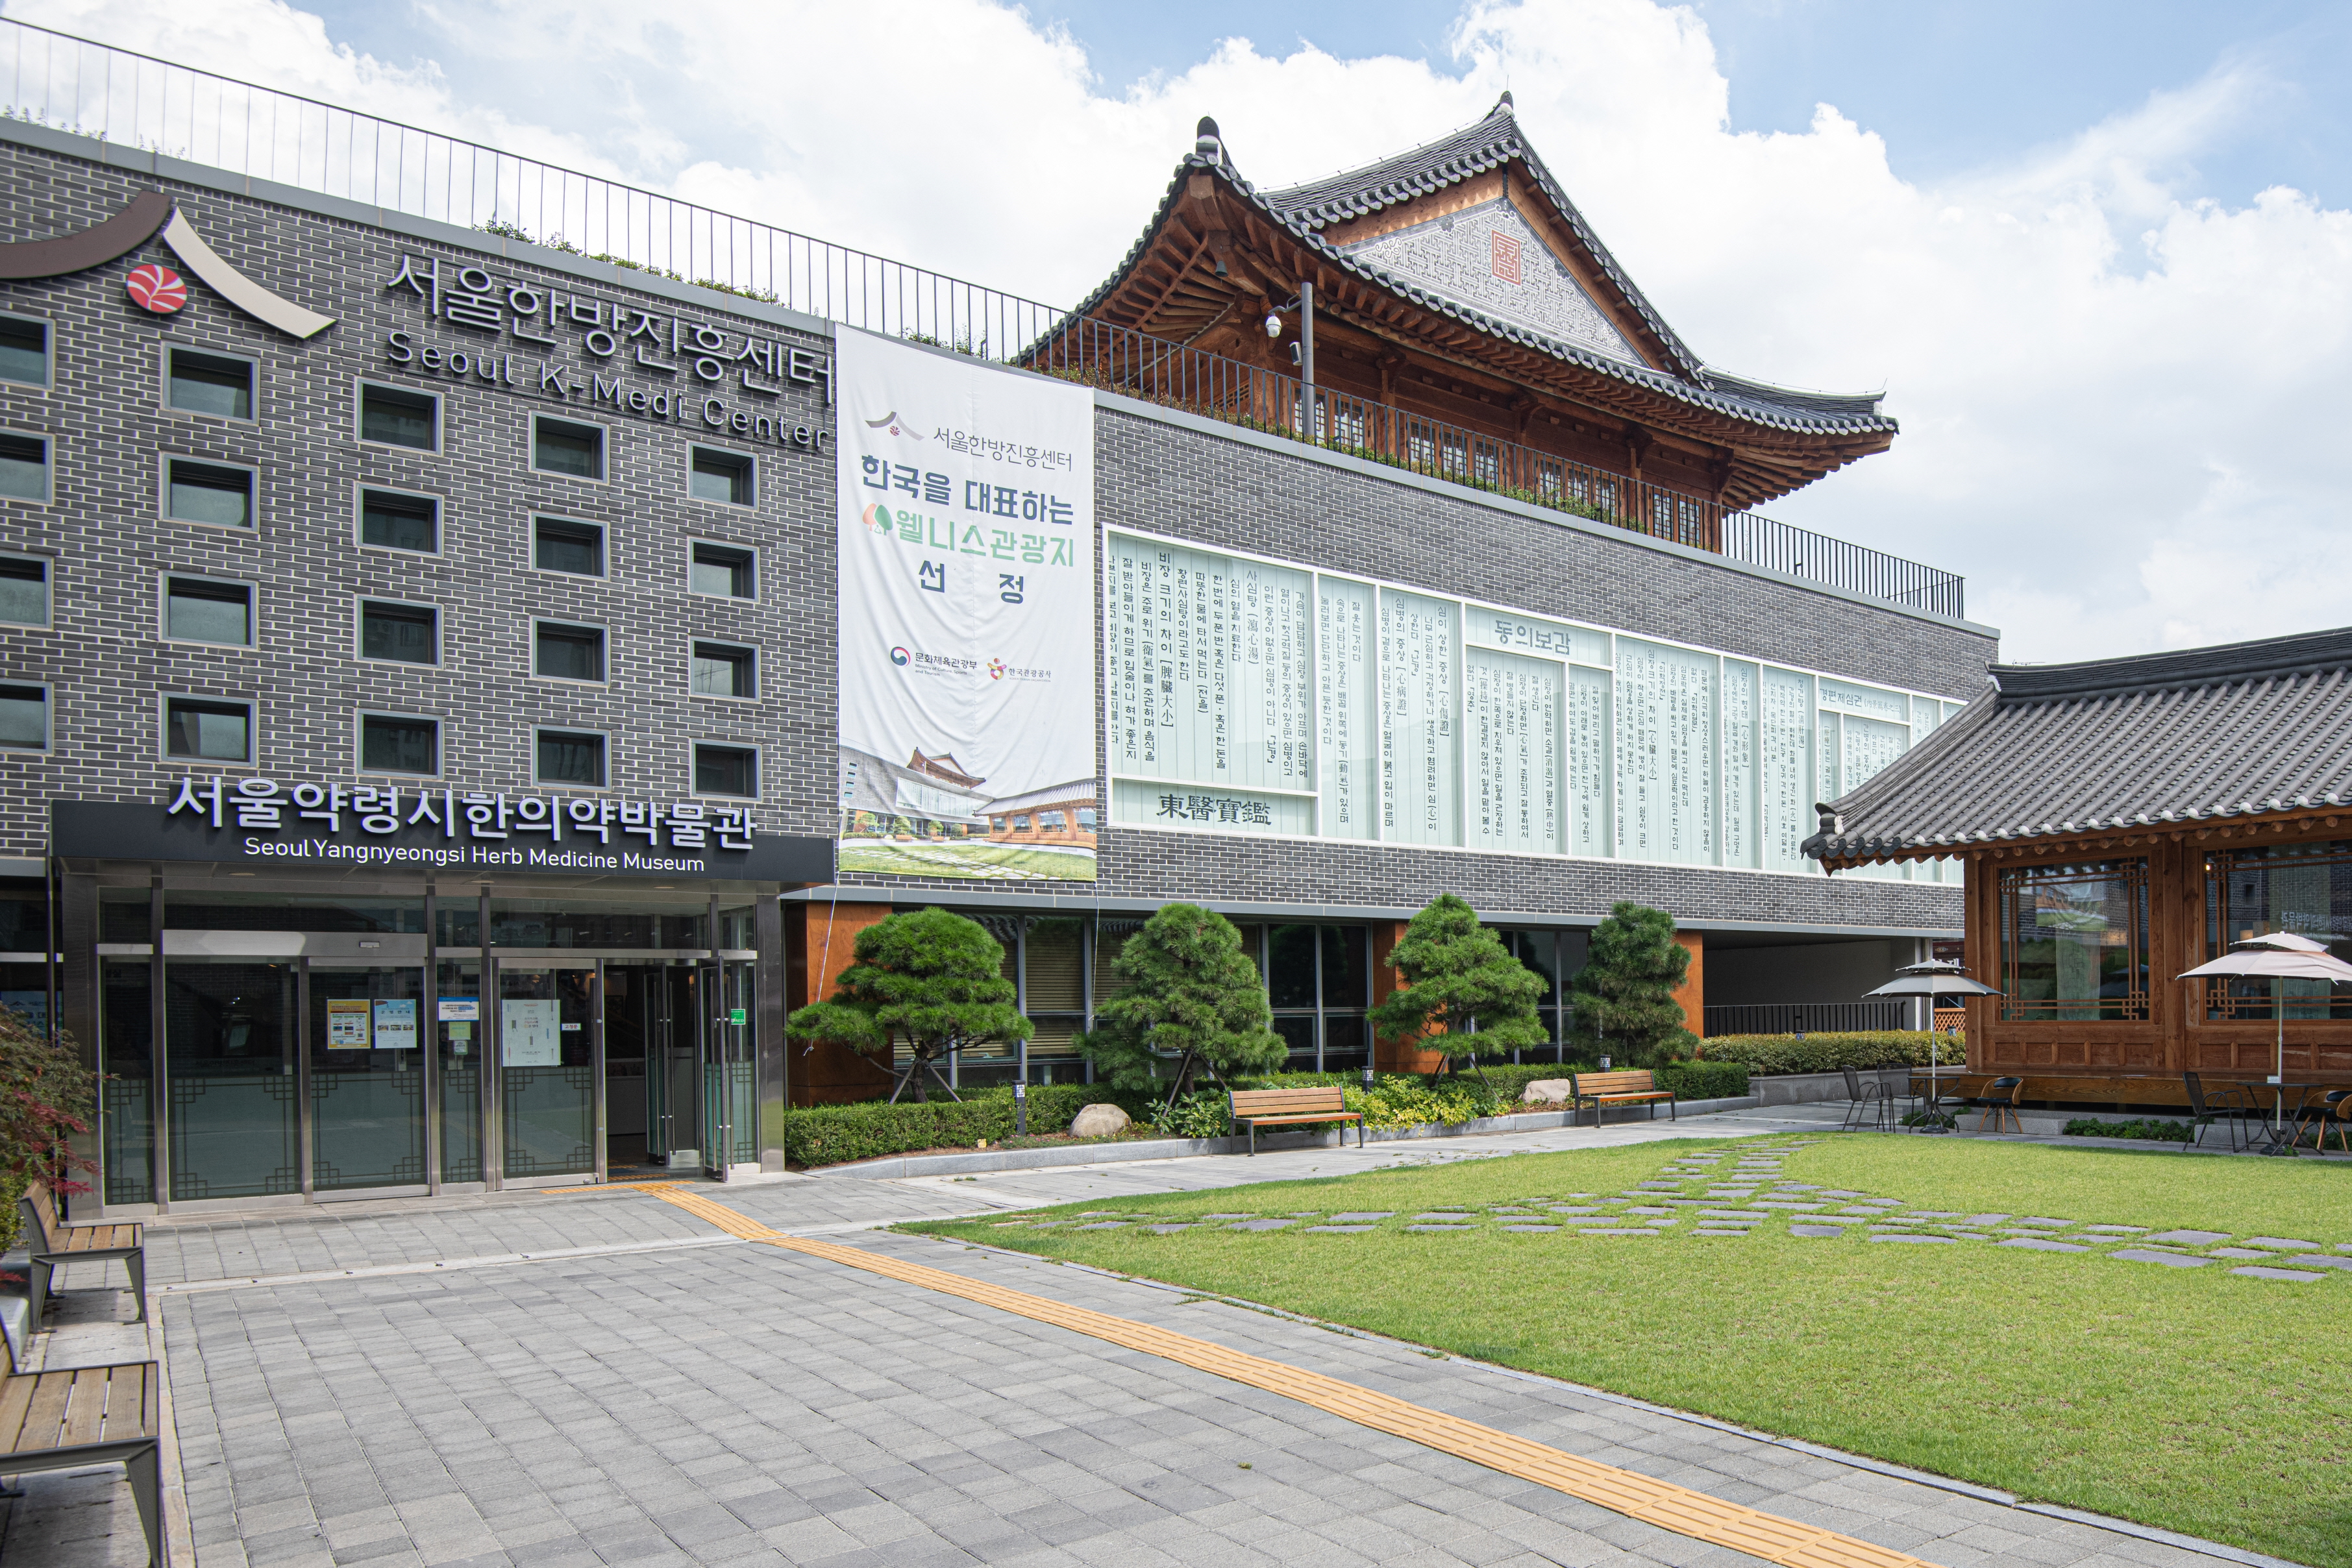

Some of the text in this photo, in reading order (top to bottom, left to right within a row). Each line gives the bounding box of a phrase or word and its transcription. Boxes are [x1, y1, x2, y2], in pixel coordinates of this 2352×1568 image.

[388, 253, 833, 405] 서울한방진흥센터
[388, 330, 829, 449] Seoul K-Medi Center
[934, 427, 1072, 472] 서울한방진흥센터
[861, 454, 1074, 525] 한국을 대표하는
[896, 509, 1074, 567] 웰니스관광지
[1142, 562, 1151, 592] 비장은
[1159, 552, 1170, 577] 비장
[1196, 572, 1206, 601] 따뜻한
[1247, 570, 1257, 607] 사심탕
[1265, 586, 1273, 604] 이런
[1143, 597, 1152, 614] 주로
[1160, 584, 1170, 622] 크기의
[1197, 604, 1206, 623] 물에
[1352, 602, 1359, 611] 잘
[1231, 580, 1241, 661] 심의 열을 치료한다
[1265, 607, 1274, 634] 증상이
[1425, 617, 1432, 631] 너무
[1439, 606, 1446, 628] 심이
[1161, 629, 1171, 653] 차이
[1197, 628, 1206, 646] 타서
[1296, 621, 1305, 656] 답답하고
[1396, 638, 1405, 661] 증상
[1439, 635, 1446, 656] 상한
[1494, 620, 1571, 655] 동의보감
[915, 652, 977, 669] 문화체육관광부
[1123, 558, 1135, 759] 잘 받아들이게 하므로 입술이나 혀가 좋은지
[1198, 650, 1207, 679] 먹는다
[1322, 635, 1330, 671] 단단하고
[1009, 668, 1051, 678] 한국관광공사
[1180, 662, 1189, 681] 한다
[1266, 668, 1274, 696] 심병이
[1282, 663, 1291, 680] 등의
[1297, 661, 1305, 679] 심장
[1439, 661, 1447, 684] 증상
[1283, 684, 1291, 709] 증상이
[1322, 676, 1330, 693] 아픈
[1144, 688, 1154, 727] 주관하며
[1267, 701, 1275, 726] 아니다
[1283, 713, 1292, 739] 있으면
[1145, 731, 1154, 761] 음식을
[1298, 742, 1307, 778] 손바닥에
[1385, 761, 1392, 778] 붉고
[1385, 781, 1392, 798] 입이
[167, 776, 758, 851] 서울약령시한의약박물관
[1156, 793, 1272, 826] 東醫寶鑑
[244, 838, 705, 872] Seoul Yangnyeongsi Herb Medicine Museum
